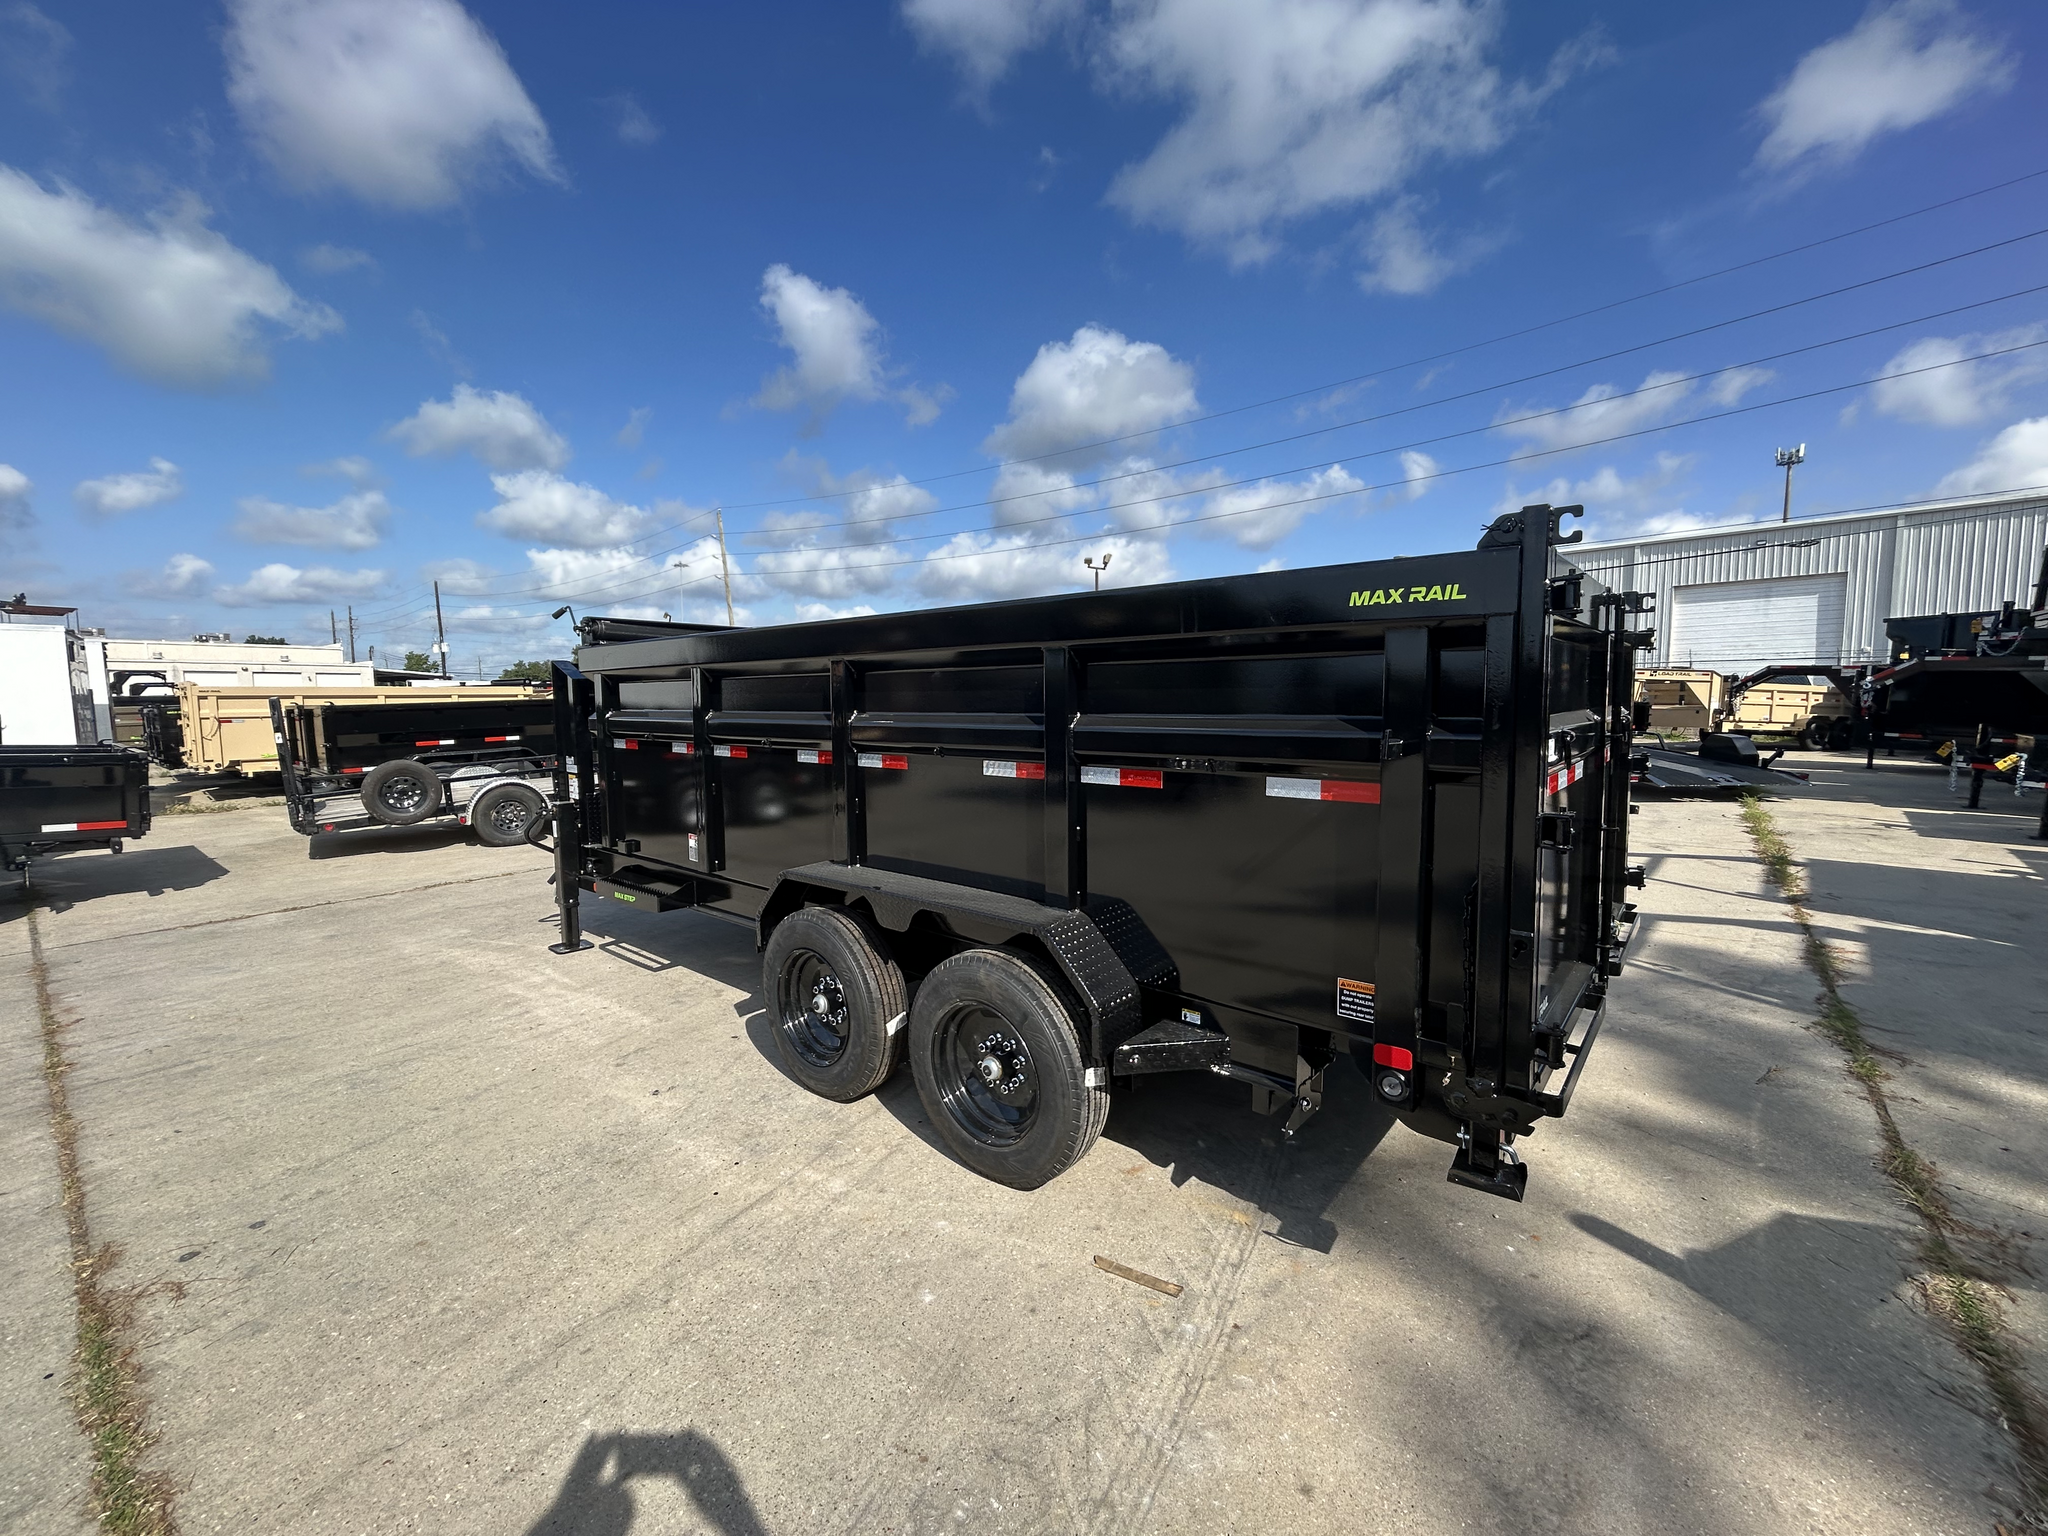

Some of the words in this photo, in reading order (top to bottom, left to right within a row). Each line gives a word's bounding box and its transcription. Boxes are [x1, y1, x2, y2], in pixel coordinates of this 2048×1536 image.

[1348, 587, 1405, 607] MAX
[1408, 583, 1468, 603] RAIL
[614, 891, 624, 900] MAX
[624, 894, 636, 903] STEP
[1346, 982, 1375, 993] WARNING
